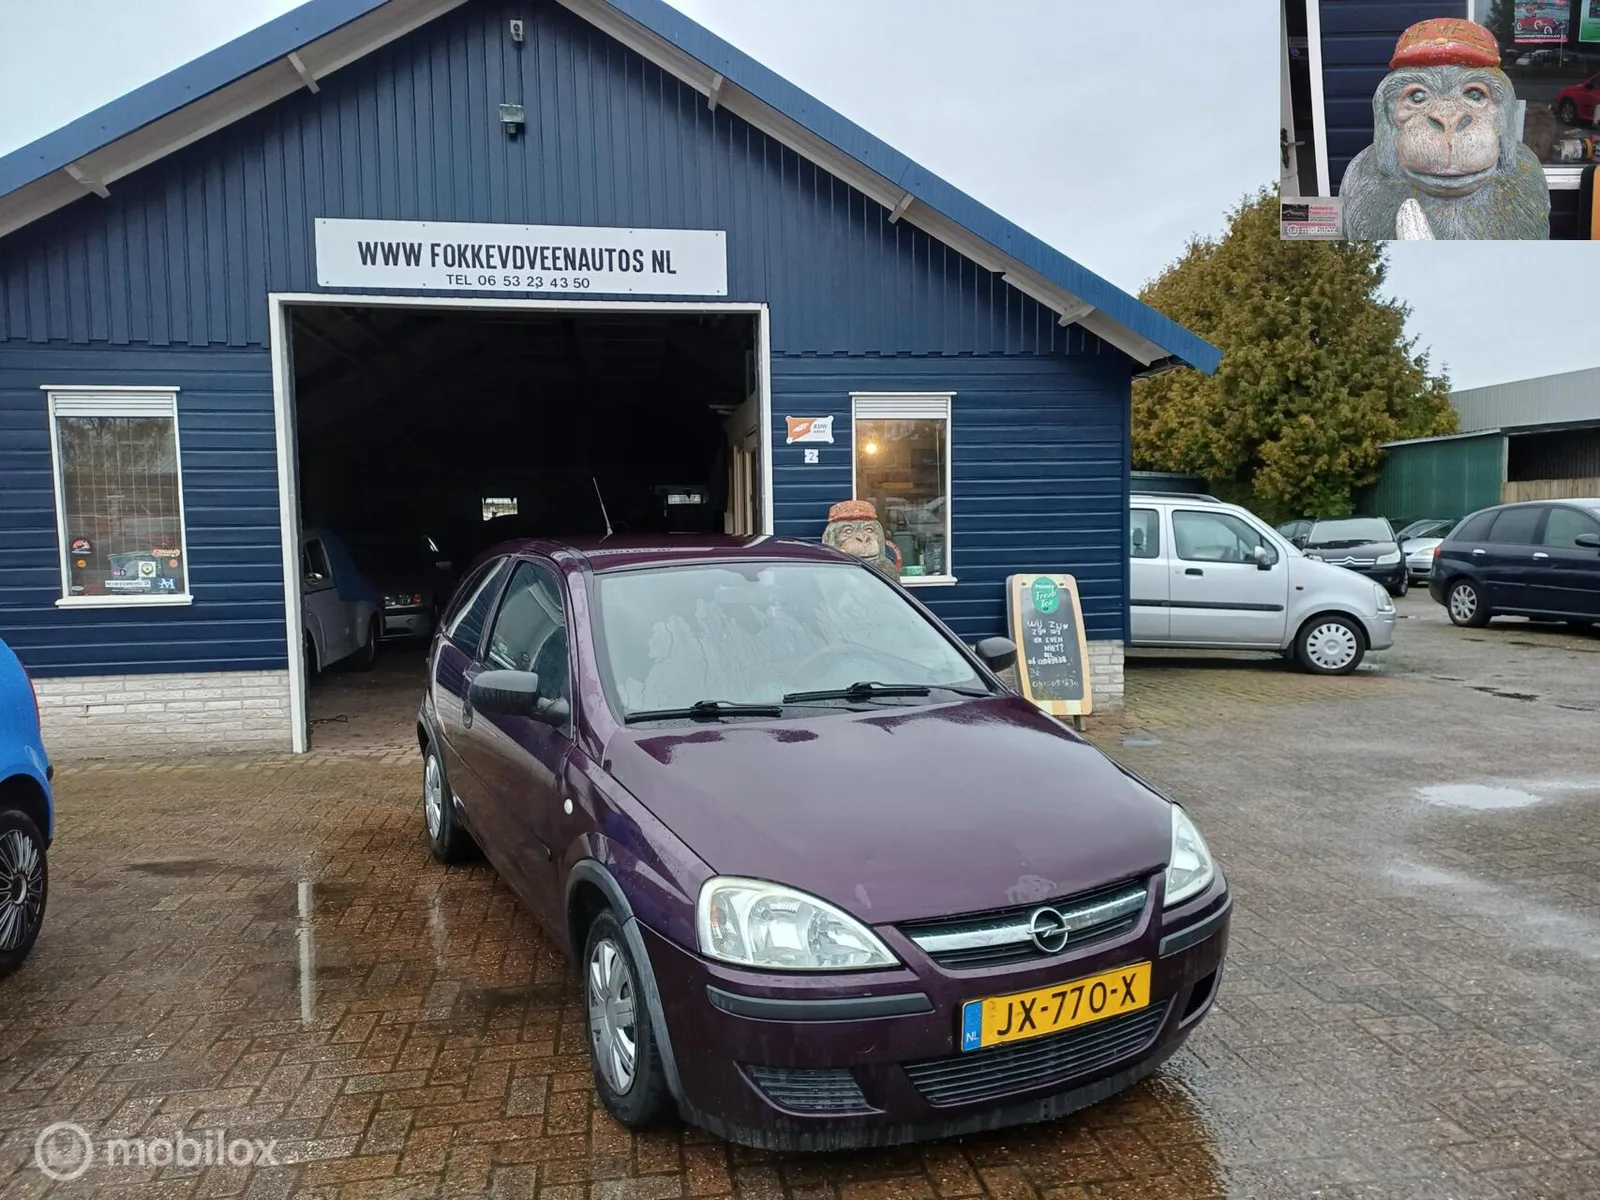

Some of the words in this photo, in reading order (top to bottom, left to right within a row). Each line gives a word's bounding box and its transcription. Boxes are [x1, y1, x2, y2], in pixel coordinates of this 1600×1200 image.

[357, 240, 422, 268] WWW
[430, 242, 645, 274] FOKKEVDVEENAUTOS
[651, 249, 677, 275] NL
[446, 273, 472, 286] TEL
[478, 274, 496, 287] 06
[502, 275, 521, 287] 53
[526, 275, 544, 288] 23
[549, 276, 568, 289] 43
[573, 278, 590, 289] 50
[809, 451, 815, 461] 2
[996, 972, 1138, 1037] JX-770-X
[966, 1030, 980, 1043] NL
